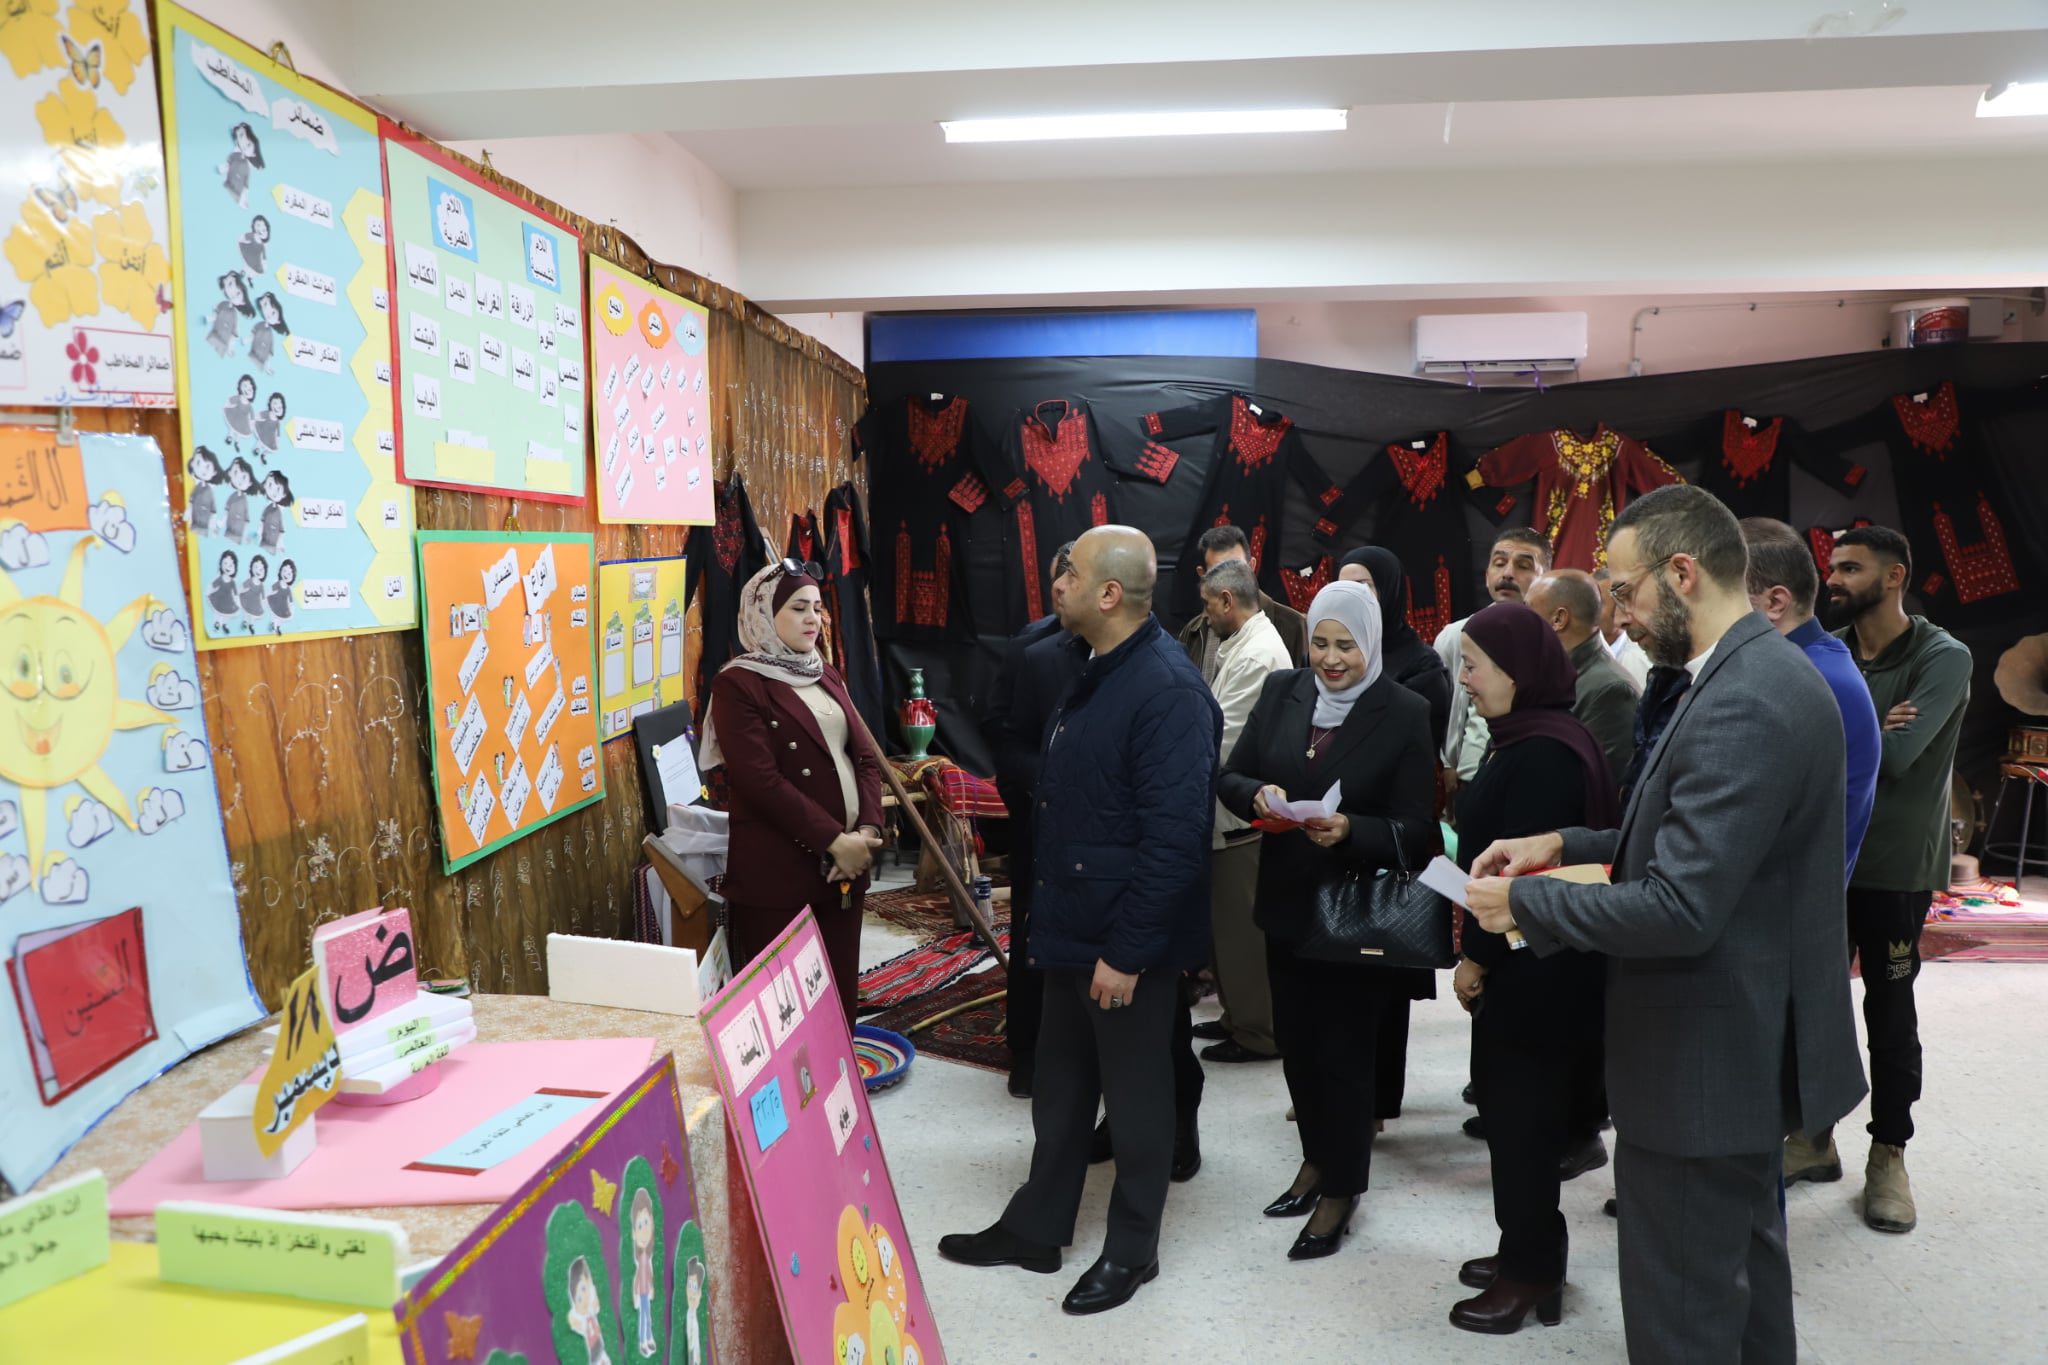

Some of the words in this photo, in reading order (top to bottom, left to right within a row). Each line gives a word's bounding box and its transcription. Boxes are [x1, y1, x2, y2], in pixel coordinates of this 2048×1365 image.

[207, 58, 252, 95] المخاطب
[290, 106, 324, 135] ضمائر
[409, 264, 437, 285] الكتاب
[105, 353, 143, 371] المخاطب
[147, 356, 170, 372] ضمائر
[417, 389, 438, 411] الباب
[335, 924, 414, 1024] ض
[397, 1019, 419, 1040] اليوم
